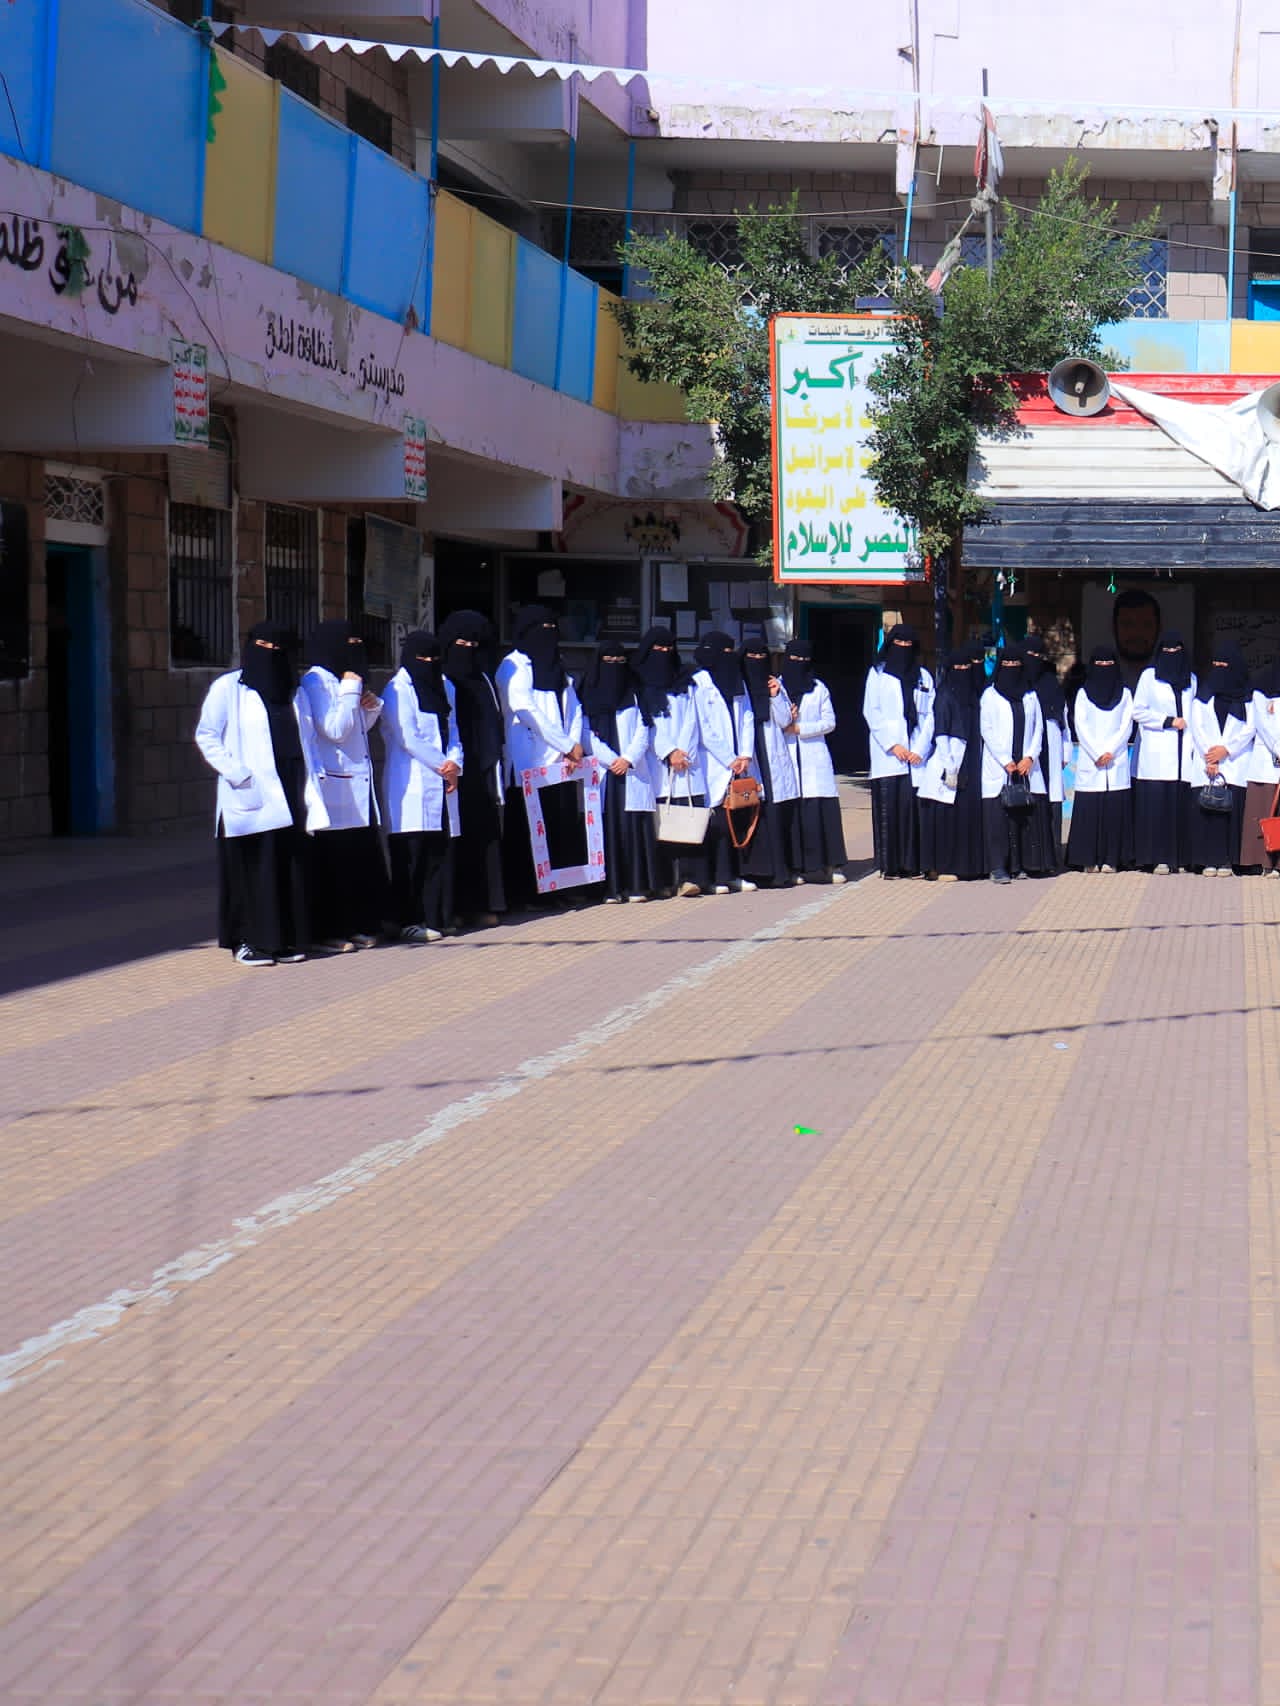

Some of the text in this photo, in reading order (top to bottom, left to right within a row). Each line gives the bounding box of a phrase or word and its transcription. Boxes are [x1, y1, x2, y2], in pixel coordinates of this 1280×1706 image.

[783, 346, 864, 401] أكبر
[787, 518, 918, 565] النصر للإسلام
